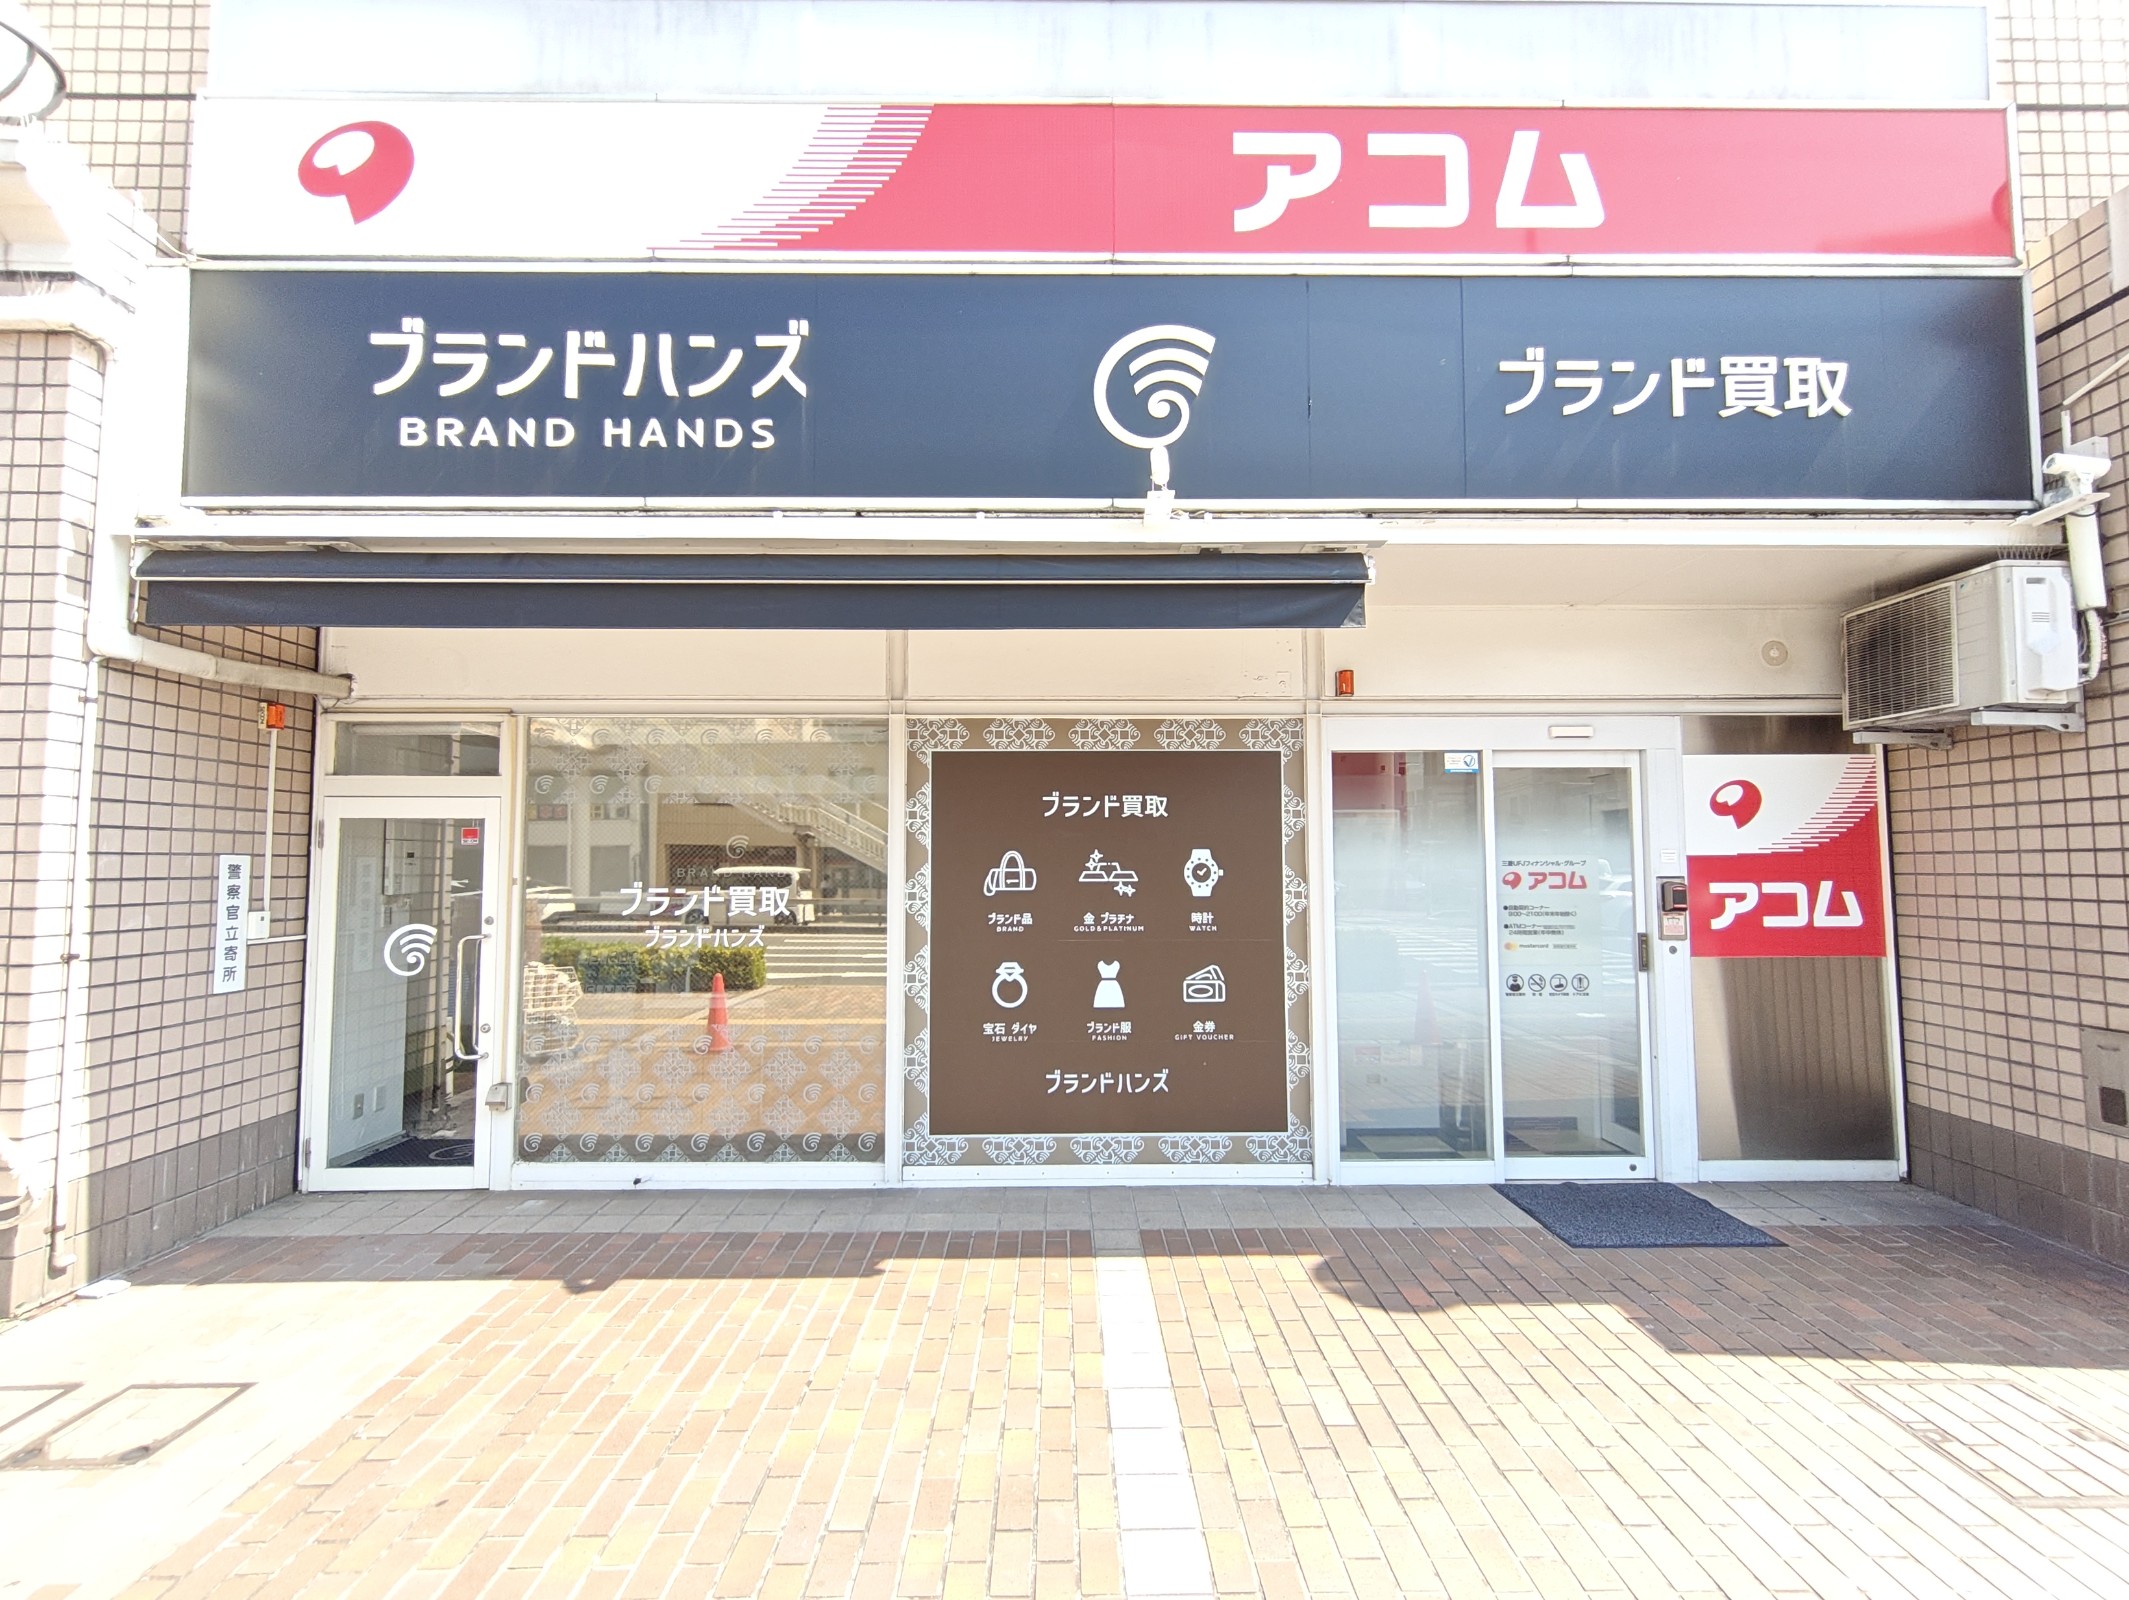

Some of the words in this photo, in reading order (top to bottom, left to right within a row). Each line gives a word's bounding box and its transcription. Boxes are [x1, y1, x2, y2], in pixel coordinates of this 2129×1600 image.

[1233, 130, 1605, 231] アコム
[370, 317, 809, 398] ブランドハンズ
[1500, 347, 1852, 417] ブランド買取
[400, 417, 575, 447] BRAND
[604, 418, 774, 448] HANDS
[1043, 792, 1168, 817] ブランド買取
[741, 868, 796, 878] HAND
[1528, 871, 1587, 890] アコム
[620, 882, 790, 916] ブランド買取
[1708, 881, 1863, 929] アコム
[222, 863, 242, 982] 警察官立寄所
[988, 913, 1033, 925] ブランド品
[1084, 913, 1095, 925] 金
[1101, 912, 1135, 925] プラチナ
[1192, 912, 1214, 924] 時計
[644, 925, 766, 949] ブランドハンズ
[983, 1023, 1006, 1035] 宝石
[1012, 1022, 1037, 1035] ダイヤ
[1087, 1022, 1132, 1034] ブランド服
[1193, 1021, 1216, 1033] 金券
[1046, 1069, 1168, 1093] ブランドハンズ
